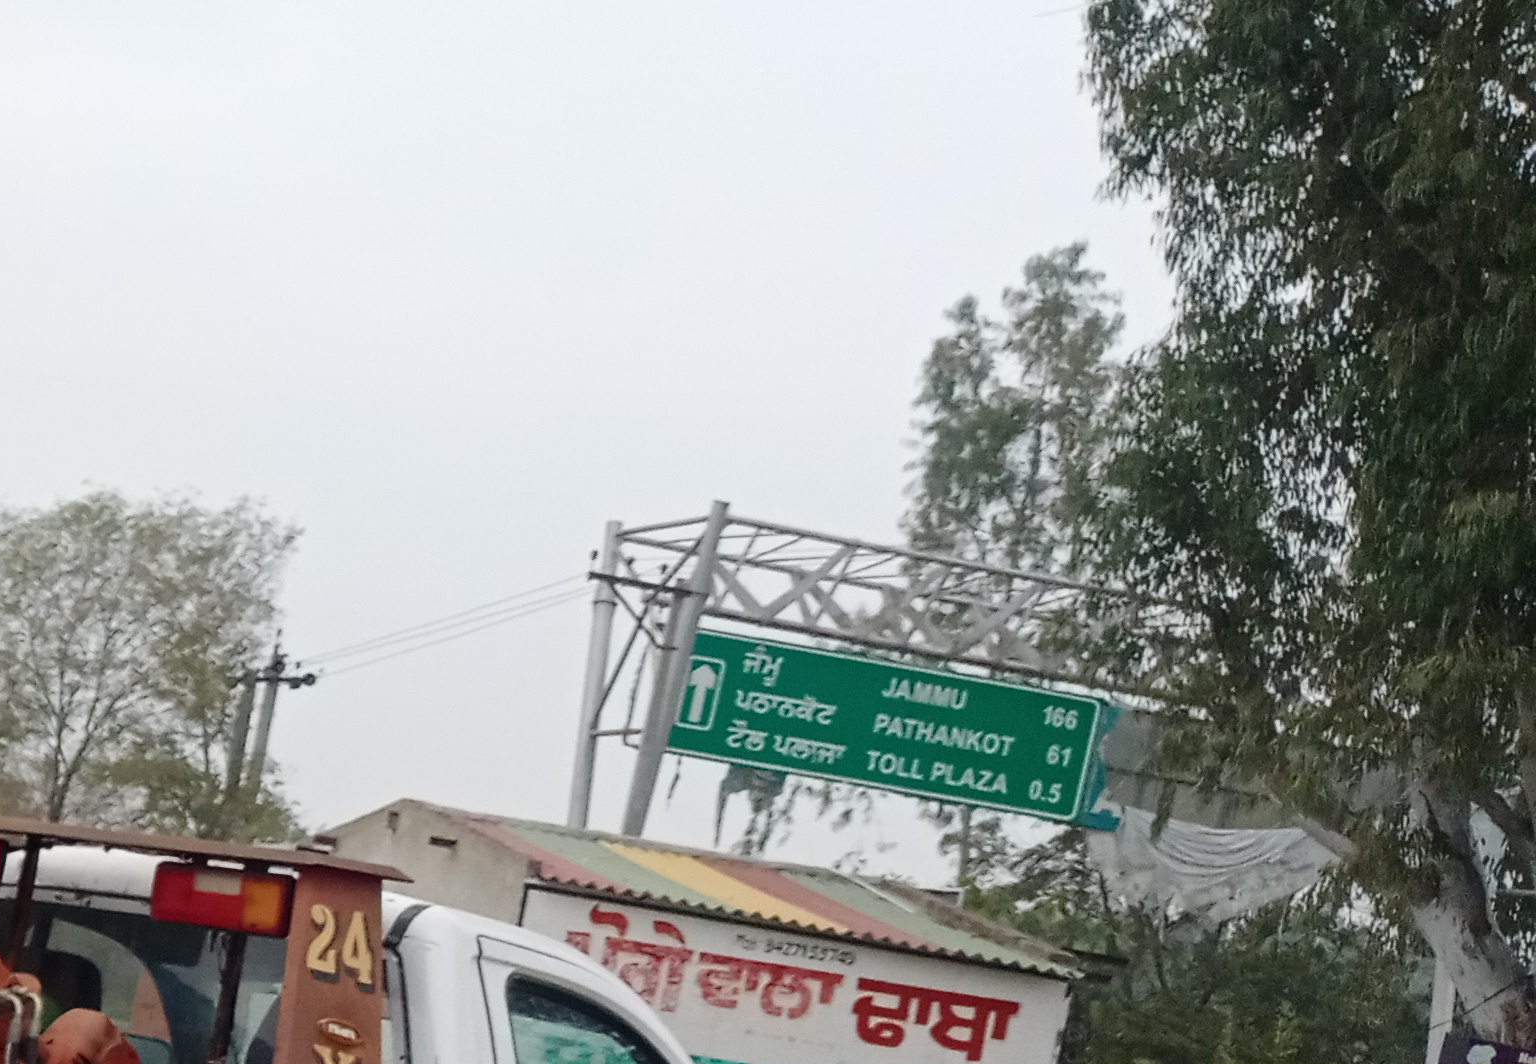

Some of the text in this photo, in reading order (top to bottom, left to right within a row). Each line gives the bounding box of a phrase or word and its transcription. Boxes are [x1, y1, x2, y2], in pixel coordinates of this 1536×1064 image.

[881, 676, 1079, 731] JAMMU 166
[872, 712, 1073, 768] PATHANKOT 61
[866, 750, 1063, 805] TOLL PLAZA 0.5
[306, 903, 375, 990] 24
[851, 976, 1021, 1063] ਢਾਬਾ
